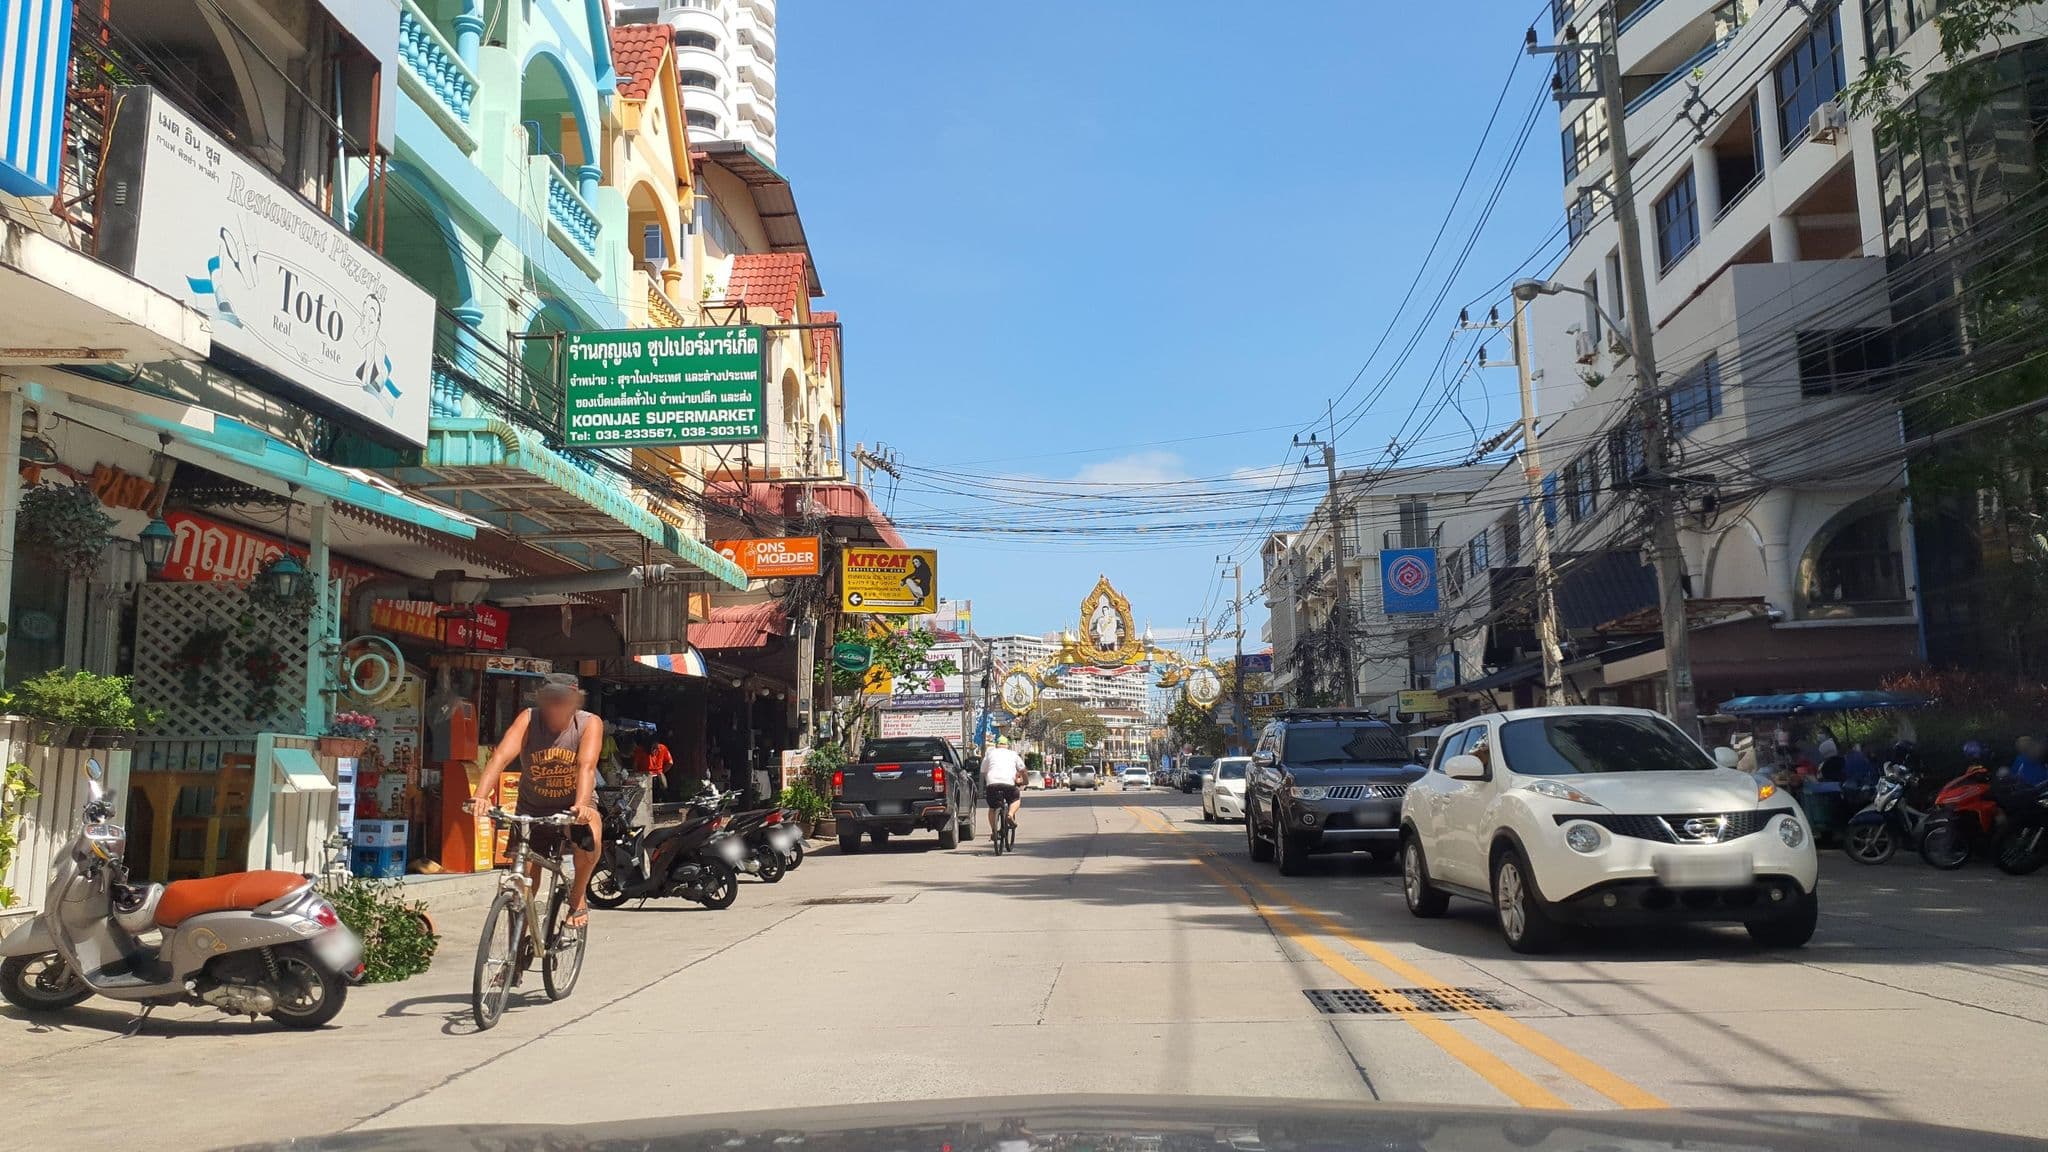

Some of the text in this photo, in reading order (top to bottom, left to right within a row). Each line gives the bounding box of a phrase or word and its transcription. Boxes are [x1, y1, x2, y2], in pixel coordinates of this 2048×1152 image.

[227, 171, 389, 304] Restaurant Pizzeria
[272, 315, 292, 338] Real
[321, 342, 343, 364] Taste
[569, 336, 641, 368] ร้านกุญแจ
[570, 373, 607, 387] จำหน่าย
[572, 409, 755, 428] KOONJAE SUPERMARKET
[570, 425, 758, 441] Tel: 038-233567, 038-303151
[95, 463, 162, 517] PAST
[756, 541, 785, 553] ONS
[756, 552, 814, 564] MOEDER
[848, 553, 911, 567] KITCAT
[482, 631, 498, 644] hours
